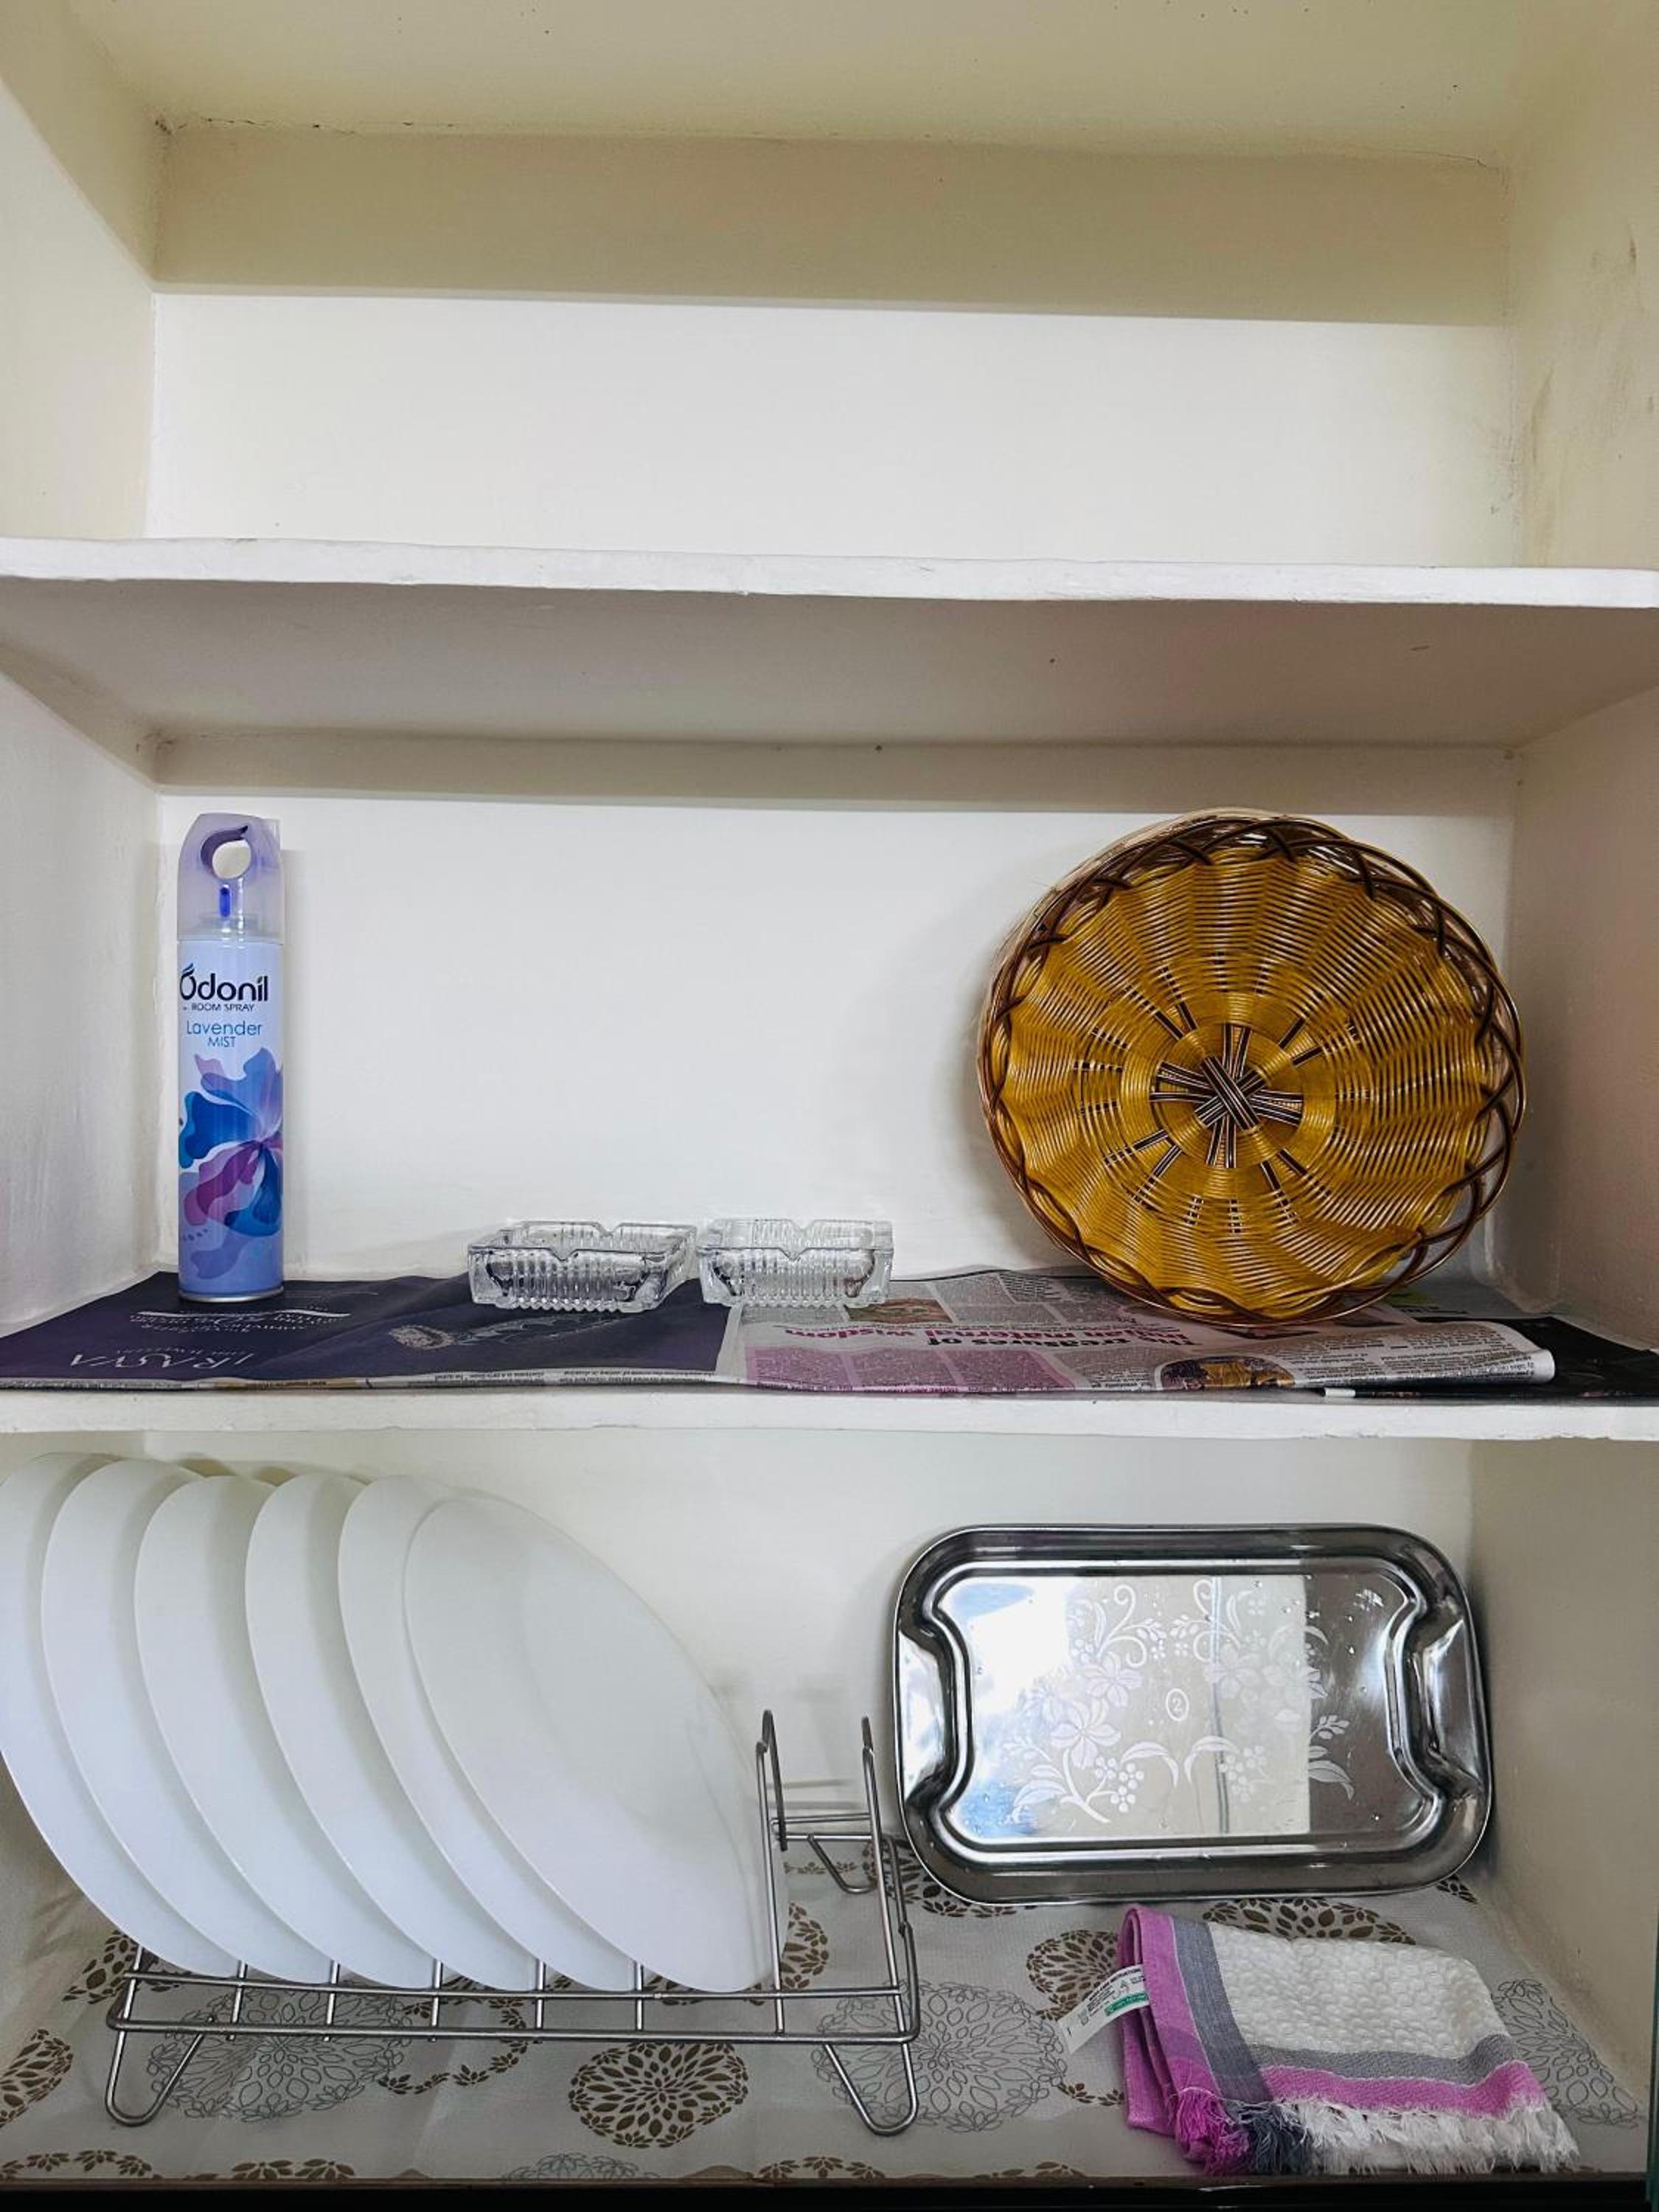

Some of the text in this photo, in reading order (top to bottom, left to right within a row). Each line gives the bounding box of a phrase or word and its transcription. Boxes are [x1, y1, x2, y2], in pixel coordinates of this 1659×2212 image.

[224, 1004, 254, 1012] SPRAY
[187, 1020, 263, 1036] Lavender
[208, 1037, 237, 1048] MIST
[783, 1329, 1189, 1340] Indian maternal wisdom
[971, 1338, 1133, 1347] treasures
